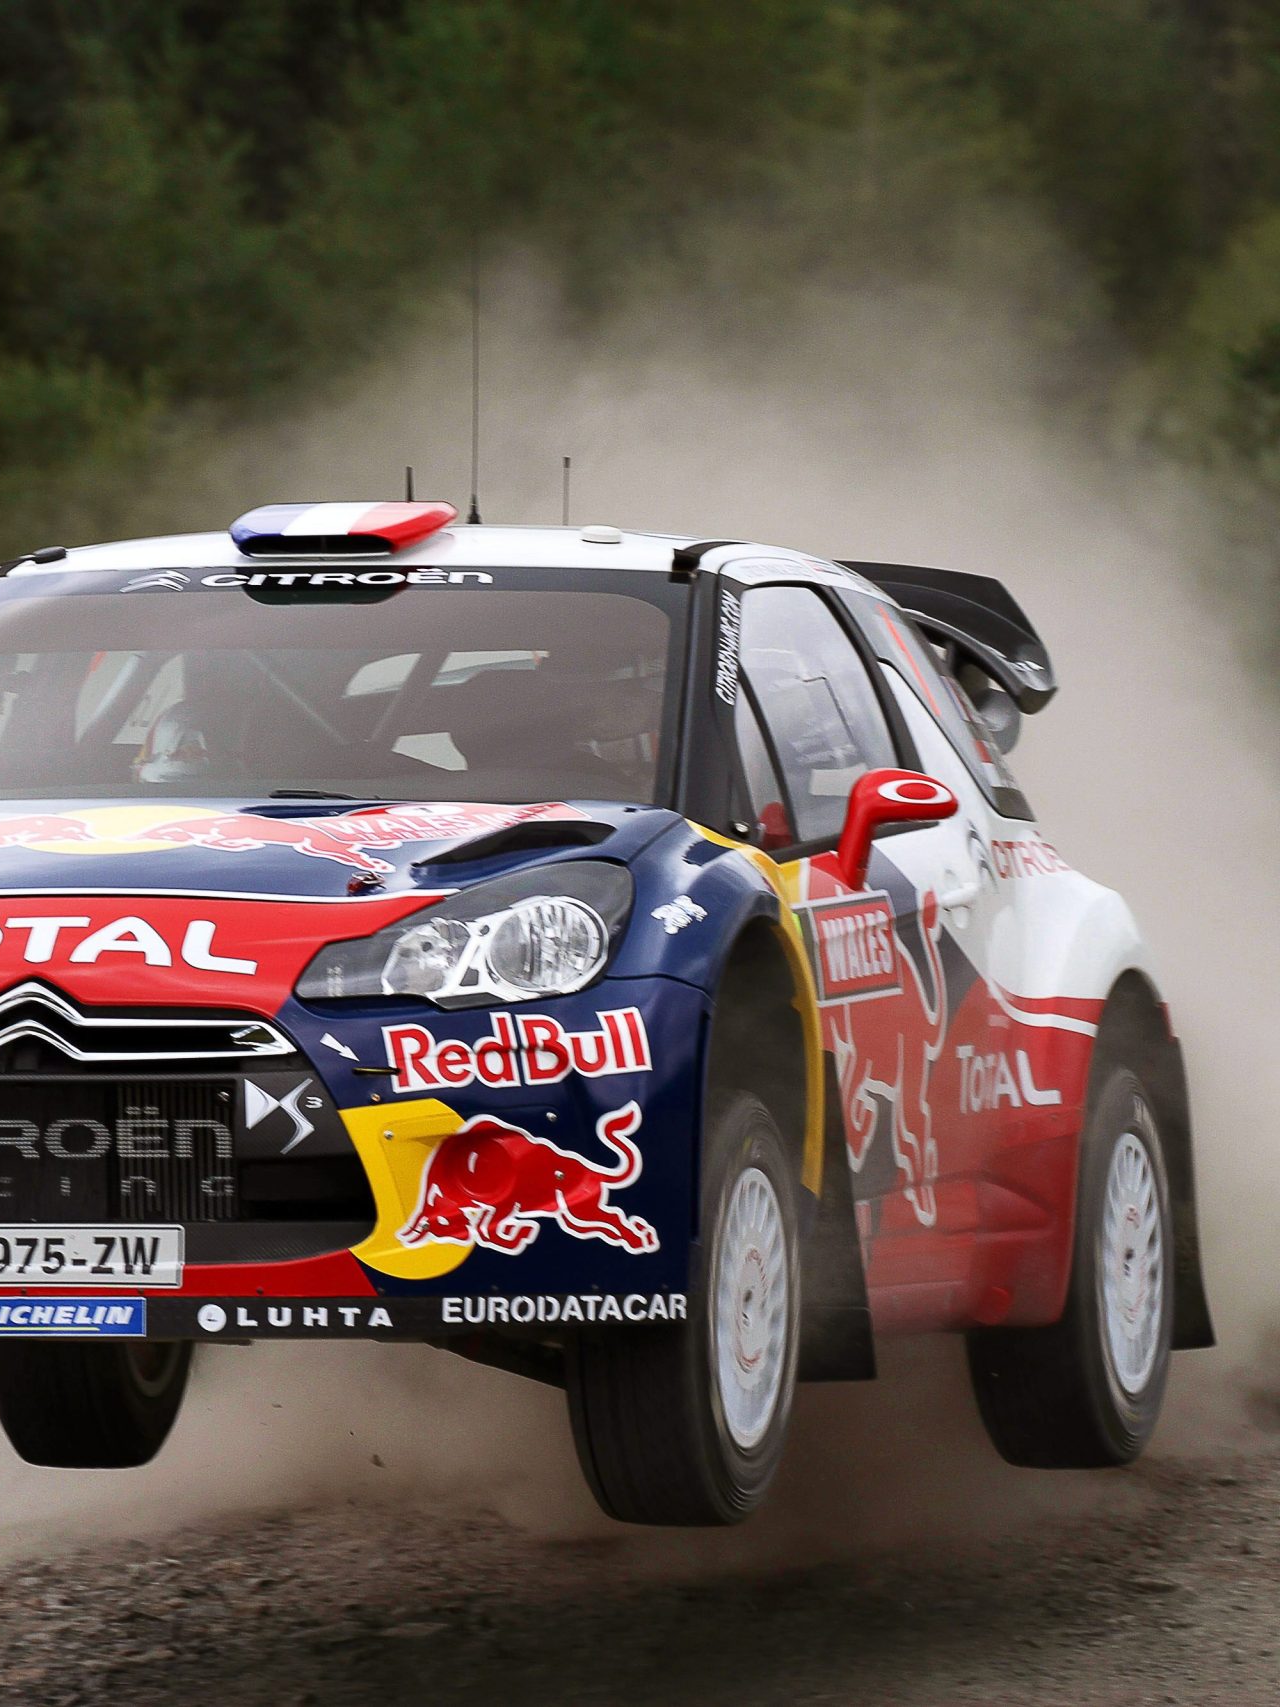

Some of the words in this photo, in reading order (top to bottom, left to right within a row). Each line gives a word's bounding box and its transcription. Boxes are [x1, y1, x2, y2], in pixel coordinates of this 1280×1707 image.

[322, 815, 477, 834] WALES
[821, 910, 894, 982] WALES
[956, 1045, 1062, 1113] TOTAL
[236, 1306, 393, 1327] LUHTA
[441, 1293, 687, 1324] EURODATACAR
